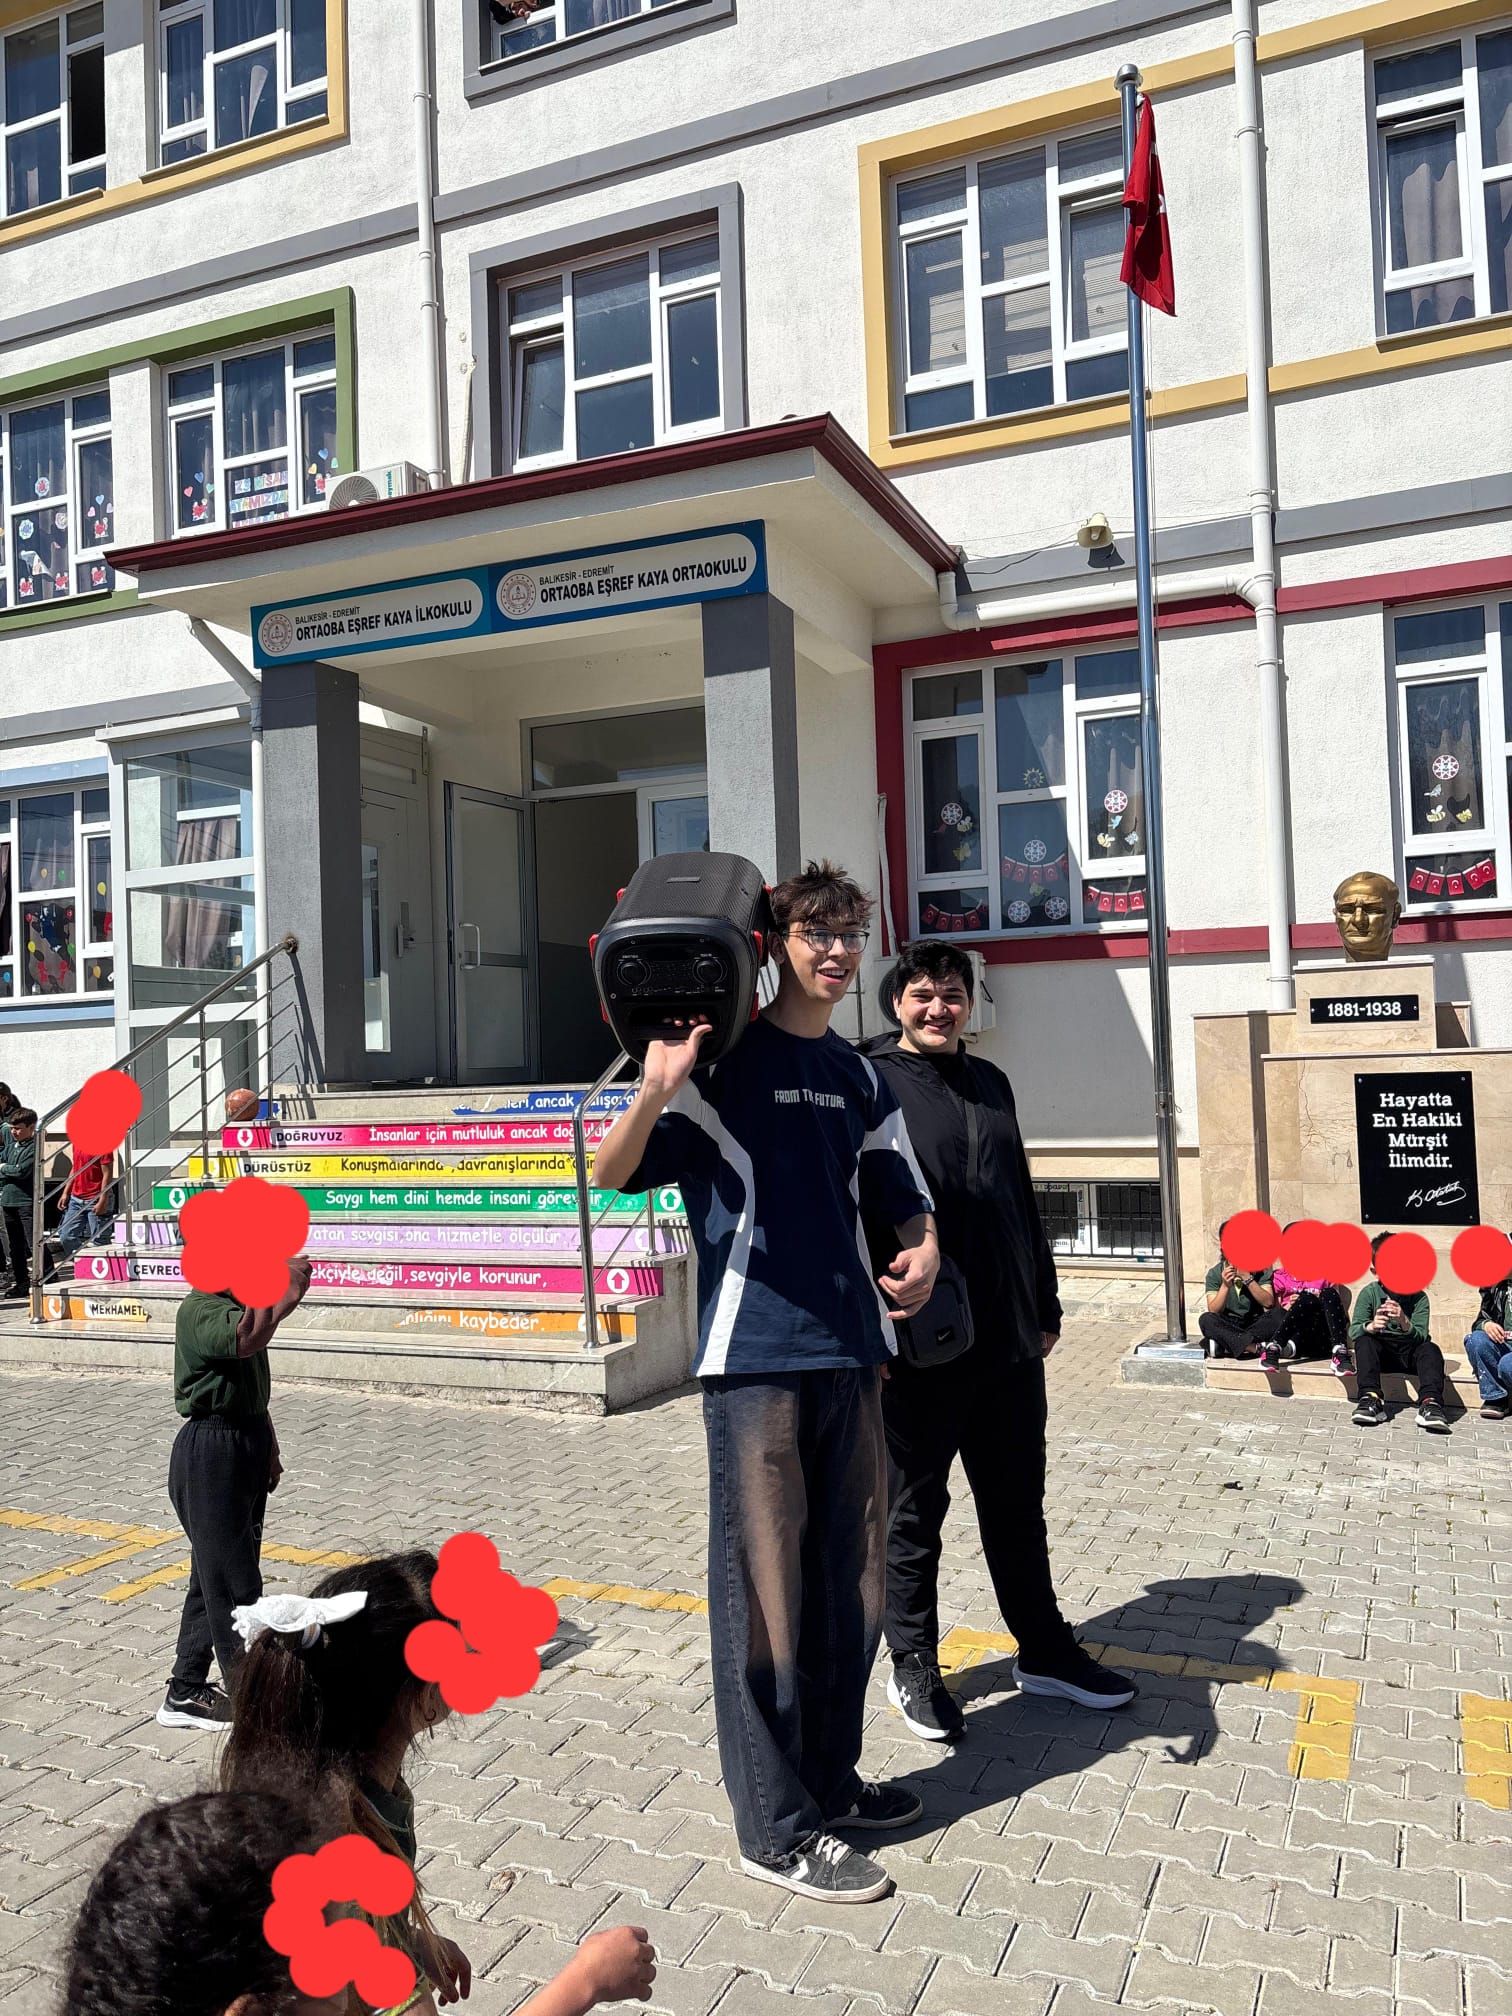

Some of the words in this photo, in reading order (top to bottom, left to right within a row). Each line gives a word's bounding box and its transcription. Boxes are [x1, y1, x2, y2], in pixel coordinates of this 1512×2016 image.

[539, 570, 577, 585] BALIKESİR
[582, 565, 615, 582] EDREMİT
[540, 581, 595, 603] ORTAOBA
[597, 575, 634, 598] EŞREF
[638, 569, 669, 589] KAYA
[672, 556, 748, 583] ORTAOKULU
[295, 610, 329, 625] BALIKESİR
[332, 606, 361, 619] EDREMİT
[296, 619, 345, 641] ORTAOBA
[347, 614, 381, 636] EŞREF
[384, 610, 413, 627] KAYA
[415, 600, 473, 623] İLKOKULU
[1327, 1001, 1402, 1017] 1881-1938
[774, 1089, 801, 1104] FROM
[814, 1092, 846, 1109] FUTURE
[1379, 1092, 1453, 1111] Hayatta
[1372, 1113, 1398, 1128] En
[1401, 1112, 1463, 1128] Hakiki
[276, 1130, 343, 1142] DOĞRUYUZ
[369, 1125, 420, 1142] İnsanlar
[425, 1127, 447, 1144] için
[452, 1124, 506, 1141] mutluluk
[510, 1124, 548, 1139] ancak
[1388, 1132, 1449, 1151] Mürşit
[243, 1160, 312, 1173] DÜRÜSTÜZ
[1388, 1149, 1454, 1169] İlimdir.
[325, 1190, 364, 1209] Saygı
[369, 1190, 398, 1205] hem
[403, 1189, 430, 1205] dini
[435, 1189, 483, 1205] hemde
[489, 1190, 531, 1205] insani
[437, 1226, 502, 1243] hizmetle
